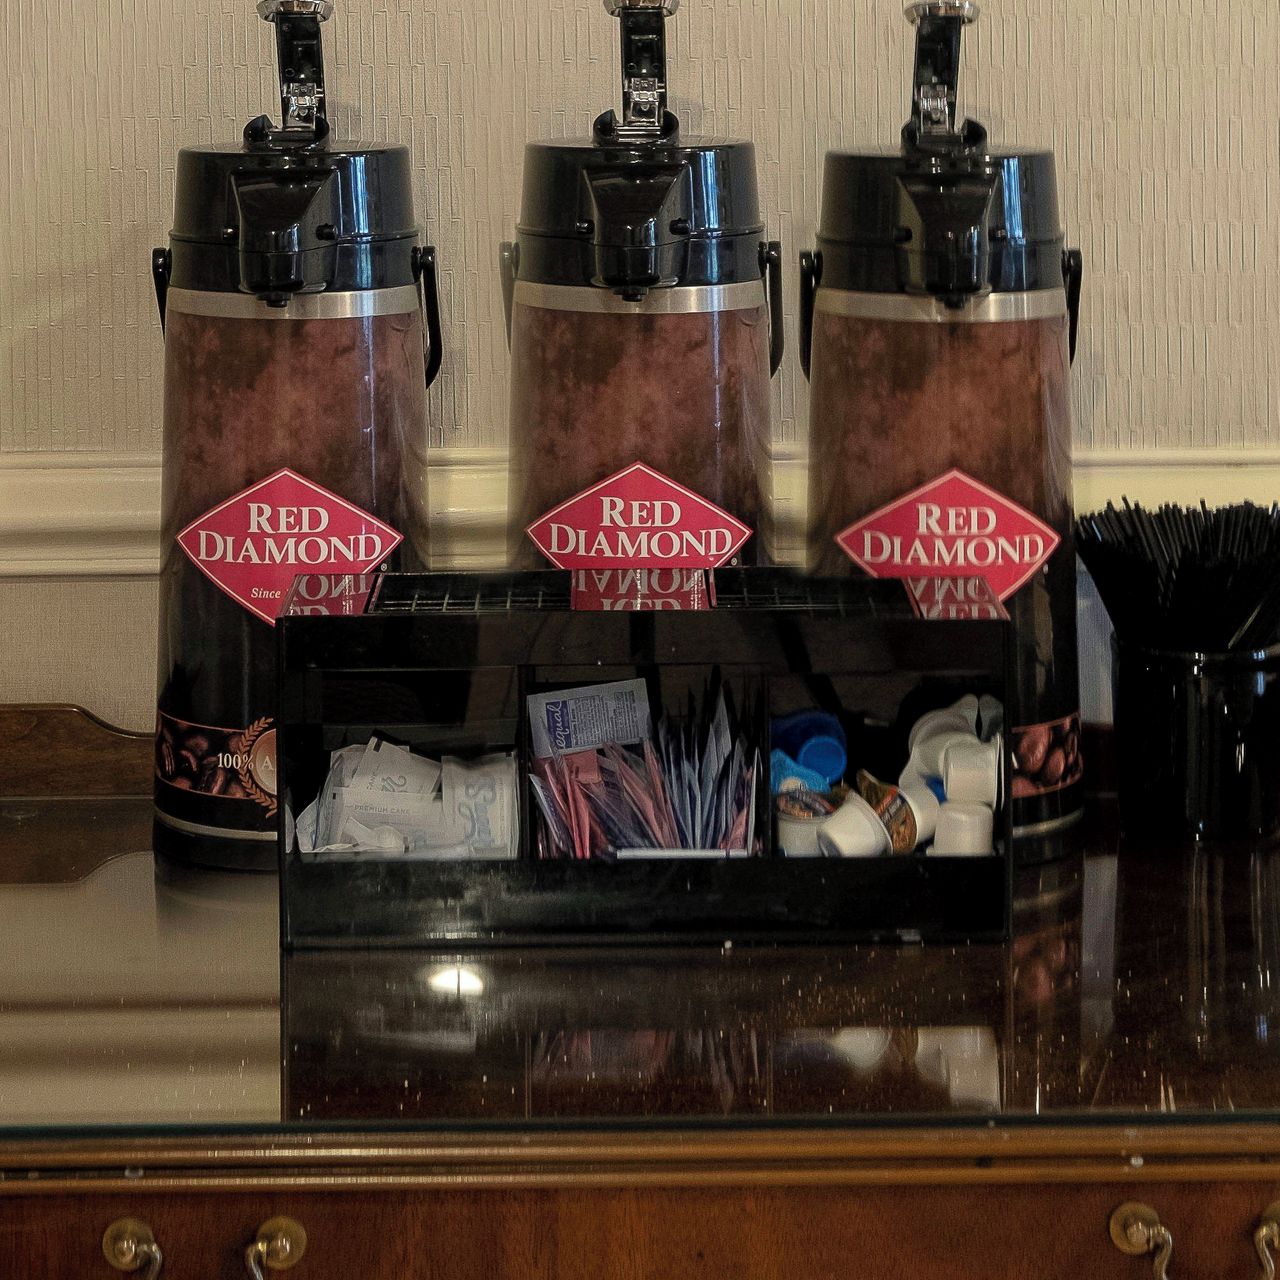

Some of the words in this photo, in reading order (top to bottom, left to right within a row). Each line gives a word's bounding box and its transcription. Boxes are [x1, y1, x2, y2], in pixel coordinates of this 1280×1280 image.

[247, 502, 330, 534] RED
[599, 496, 681, 528] RED
[916, 502, 997, 536] RED
[198, 530, 382, 565] DIAMOND
[549, 523, 732, 558] DIAMOND
[862, 530, 1044, 567] DIAMOND
[250, 587, 281, 599] Since
[547, 701, 570, 749] equal
[217, 752, 254, 770] 100%
[353, 804, 388, 814] PREMIUM
